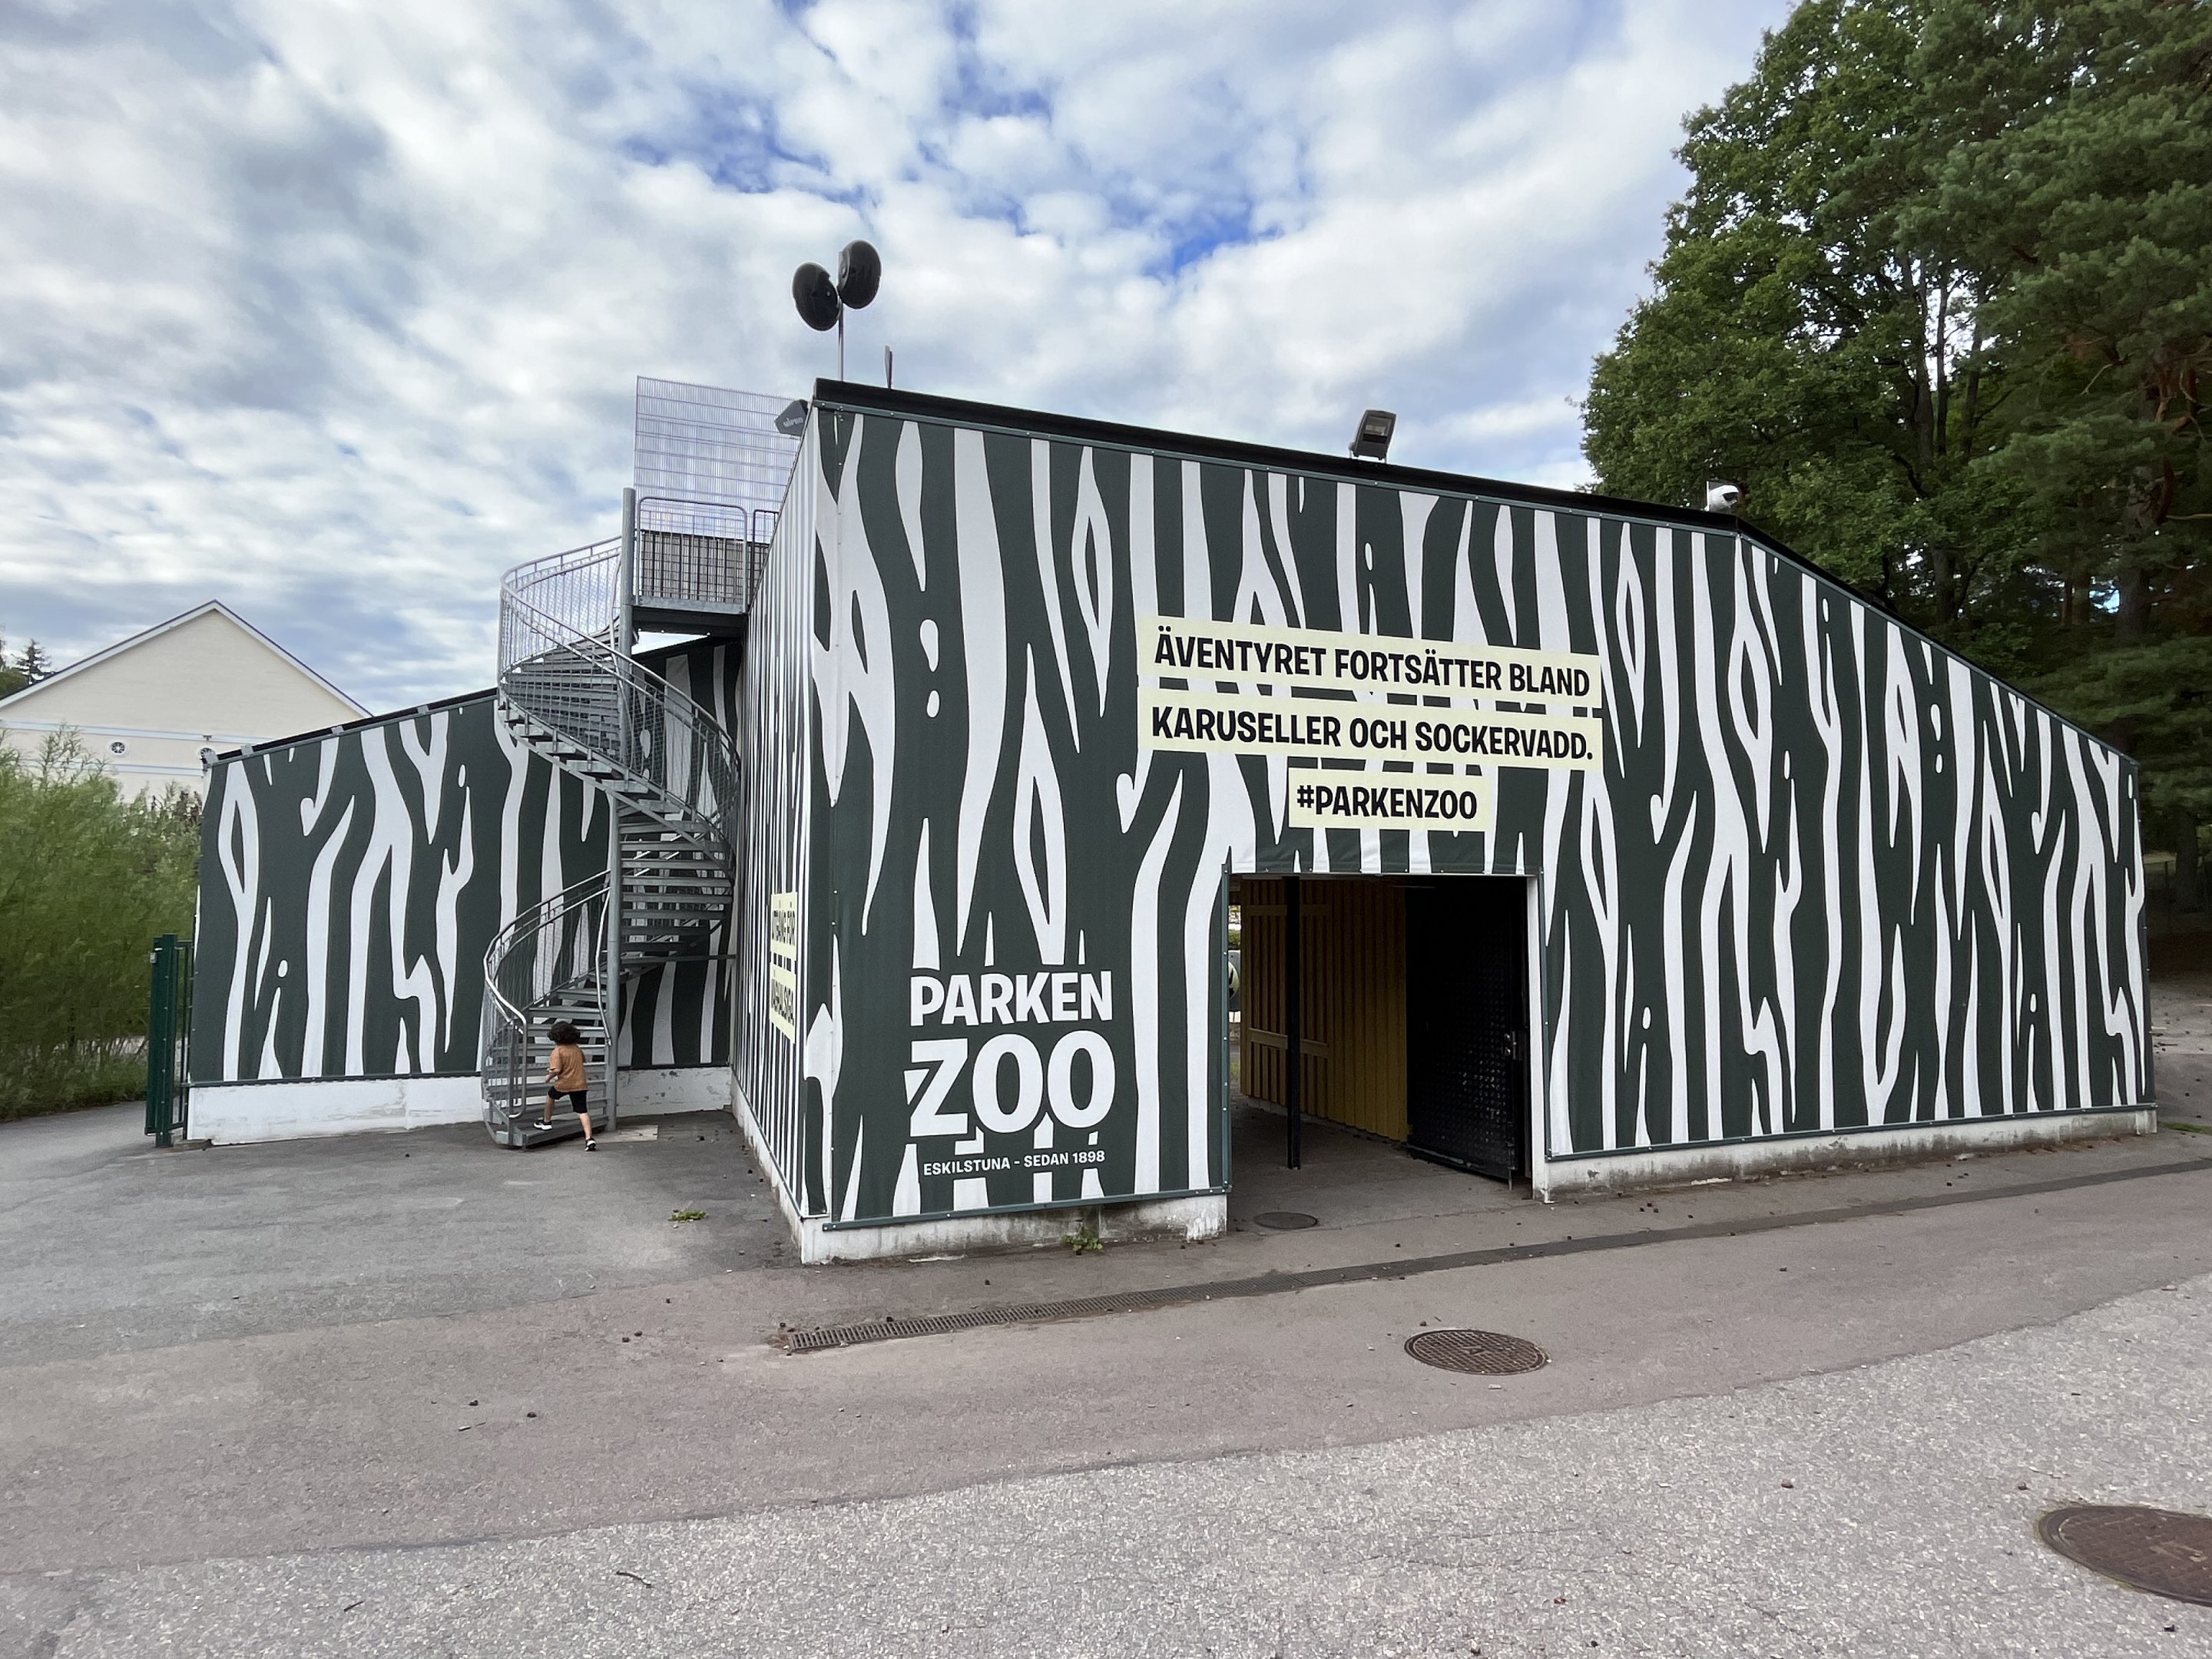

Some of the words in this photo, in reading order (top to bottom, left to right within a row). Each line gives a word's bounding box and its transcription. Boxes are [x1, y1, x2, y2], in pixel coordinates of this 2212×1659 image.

[1154, 625, 1326, 676] ÄVENTYRET
[1335, 649, 1502, 690] FORTSÄTTER
[1509, 664, 1590, 697] BLAND
[1152, 706, 1341, 747] KARUSELLER
[1349, 717, 1407, 750] OCH
[1415, 721, 1594, 760] SOCKERVADD.
[1296, 784, 1478, 820] #PARKENZOO
[910, 971, 1113, 1026] PARKEN
[910, 1030, 1116, 1137] ZOO
[923, 1157, 1011, 1176] ESKILSTUNA
[1024, 1152, 1069, 1167] SEDAN
[1072, 1150, 1105, 1164] 1898
